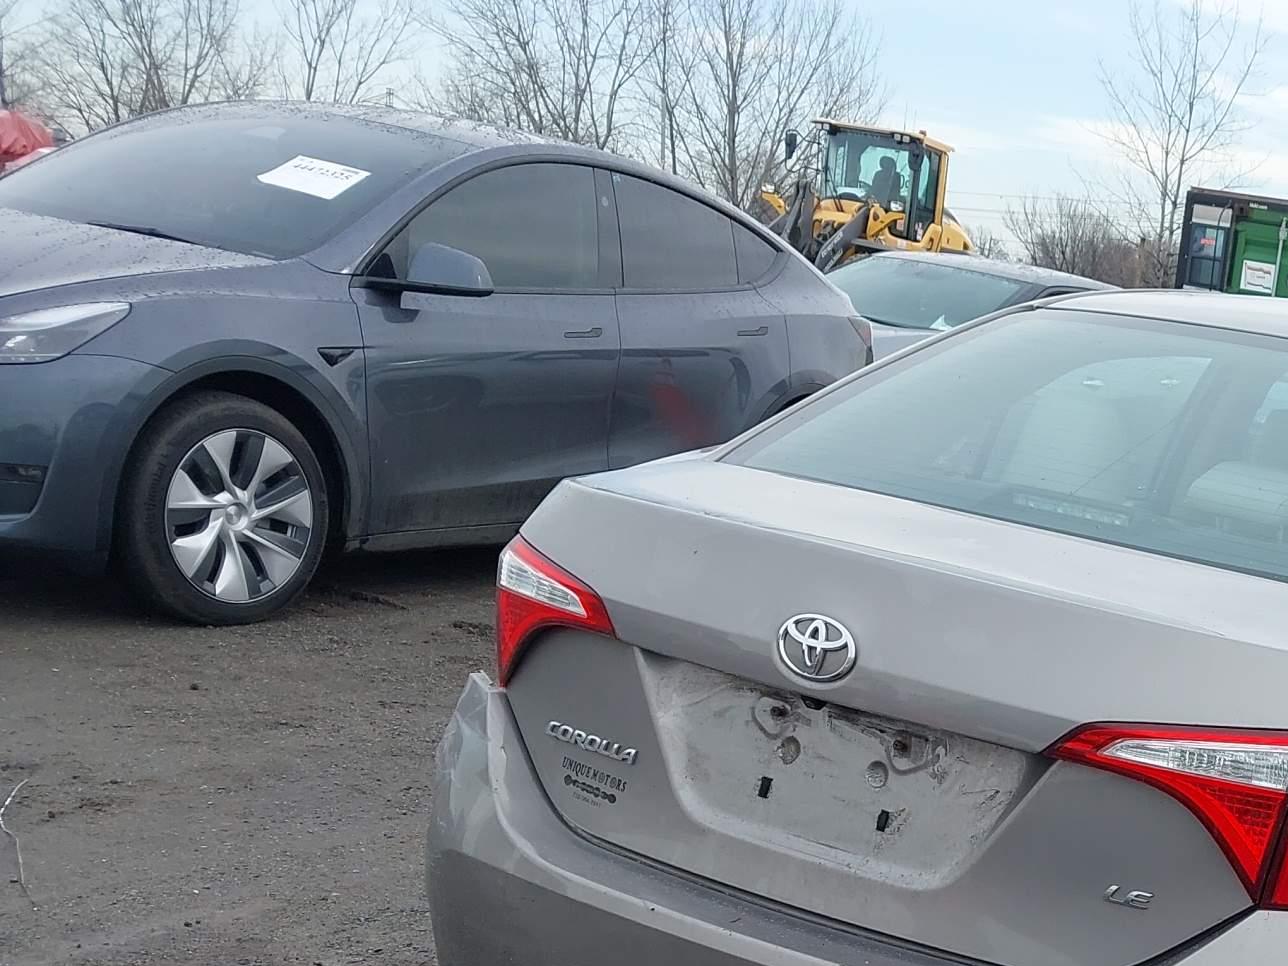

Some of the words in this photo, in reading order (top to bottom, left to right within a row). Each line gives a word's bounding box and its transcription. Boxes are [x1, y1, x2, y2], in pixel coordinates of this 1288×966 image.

[545, 720, 639, 765] COROLLA
[562, 756, 592, 777] UNIQUE
[1104, 885, 1154, 910] LE
